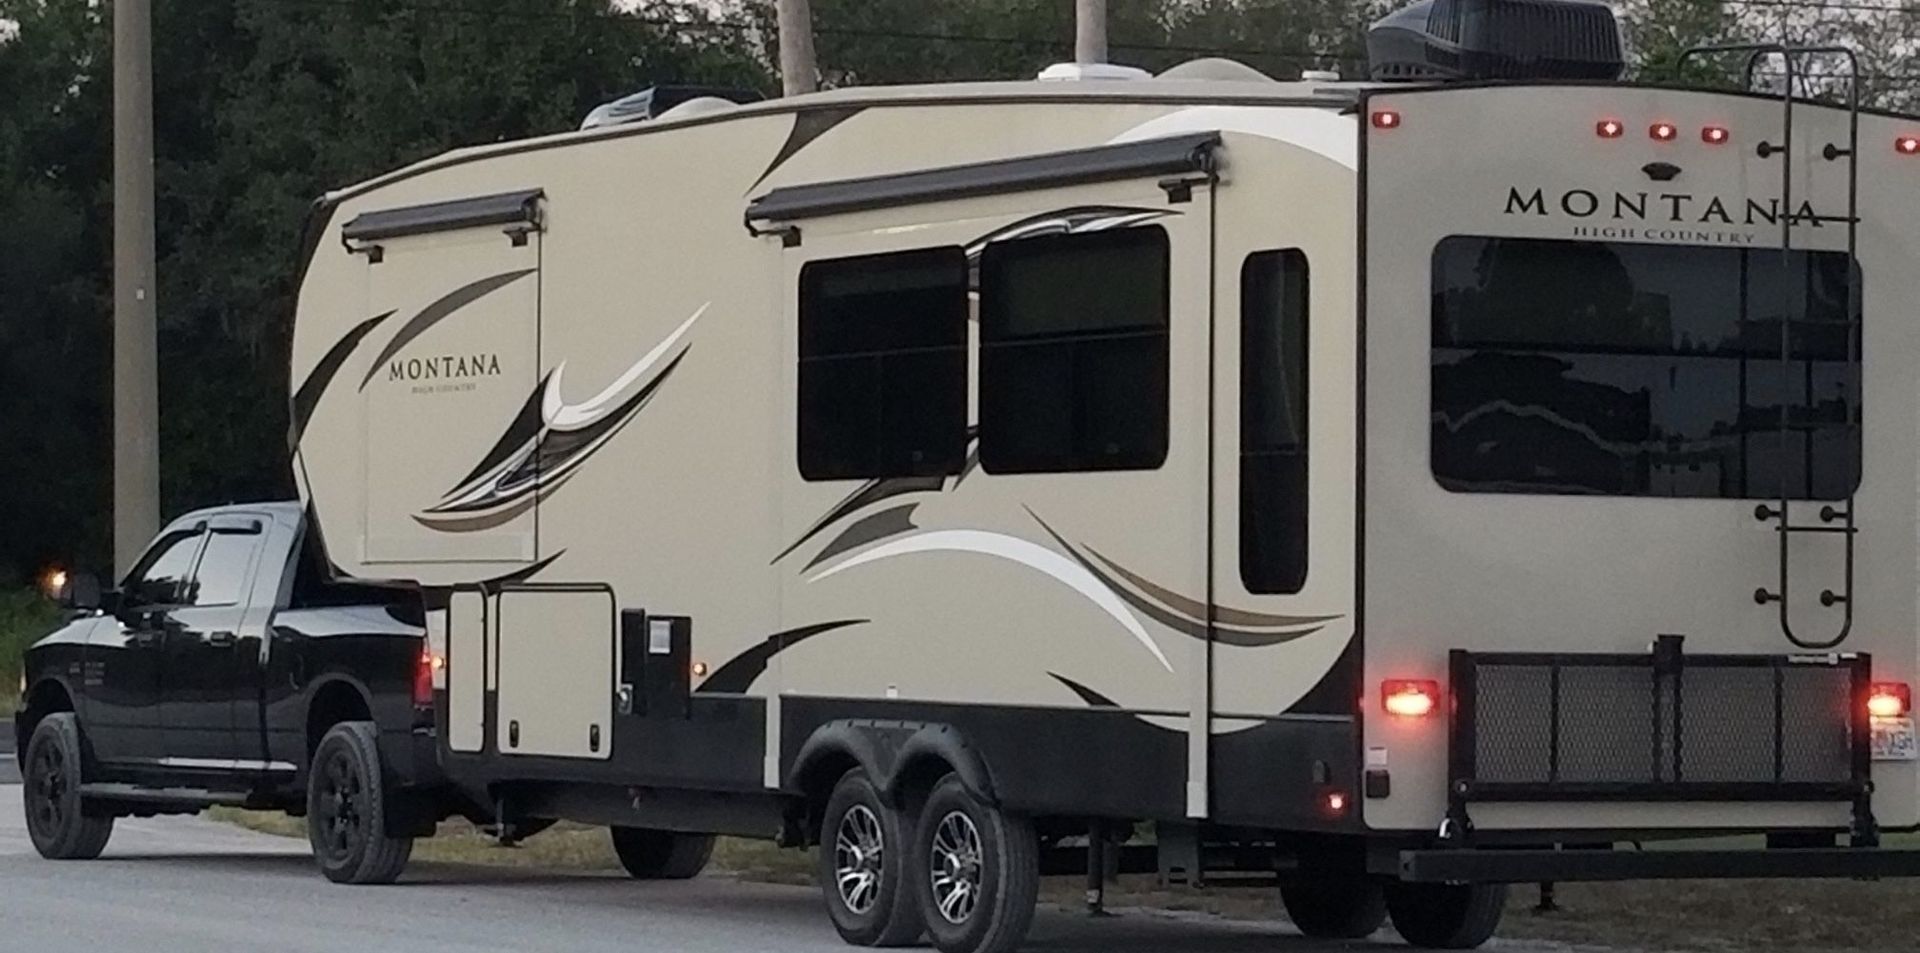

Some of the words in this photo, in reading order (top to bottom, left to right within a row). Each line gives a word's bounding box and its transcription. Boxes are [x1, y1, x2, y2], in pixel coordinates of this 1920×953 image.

[1503, 186, 1824, 228] MONTANA
[1573, 226, 1635, 239] HIGH
[1643, 229, 1756, 244] COUNTRY
[389, 354, 501, 381] MONTANA
